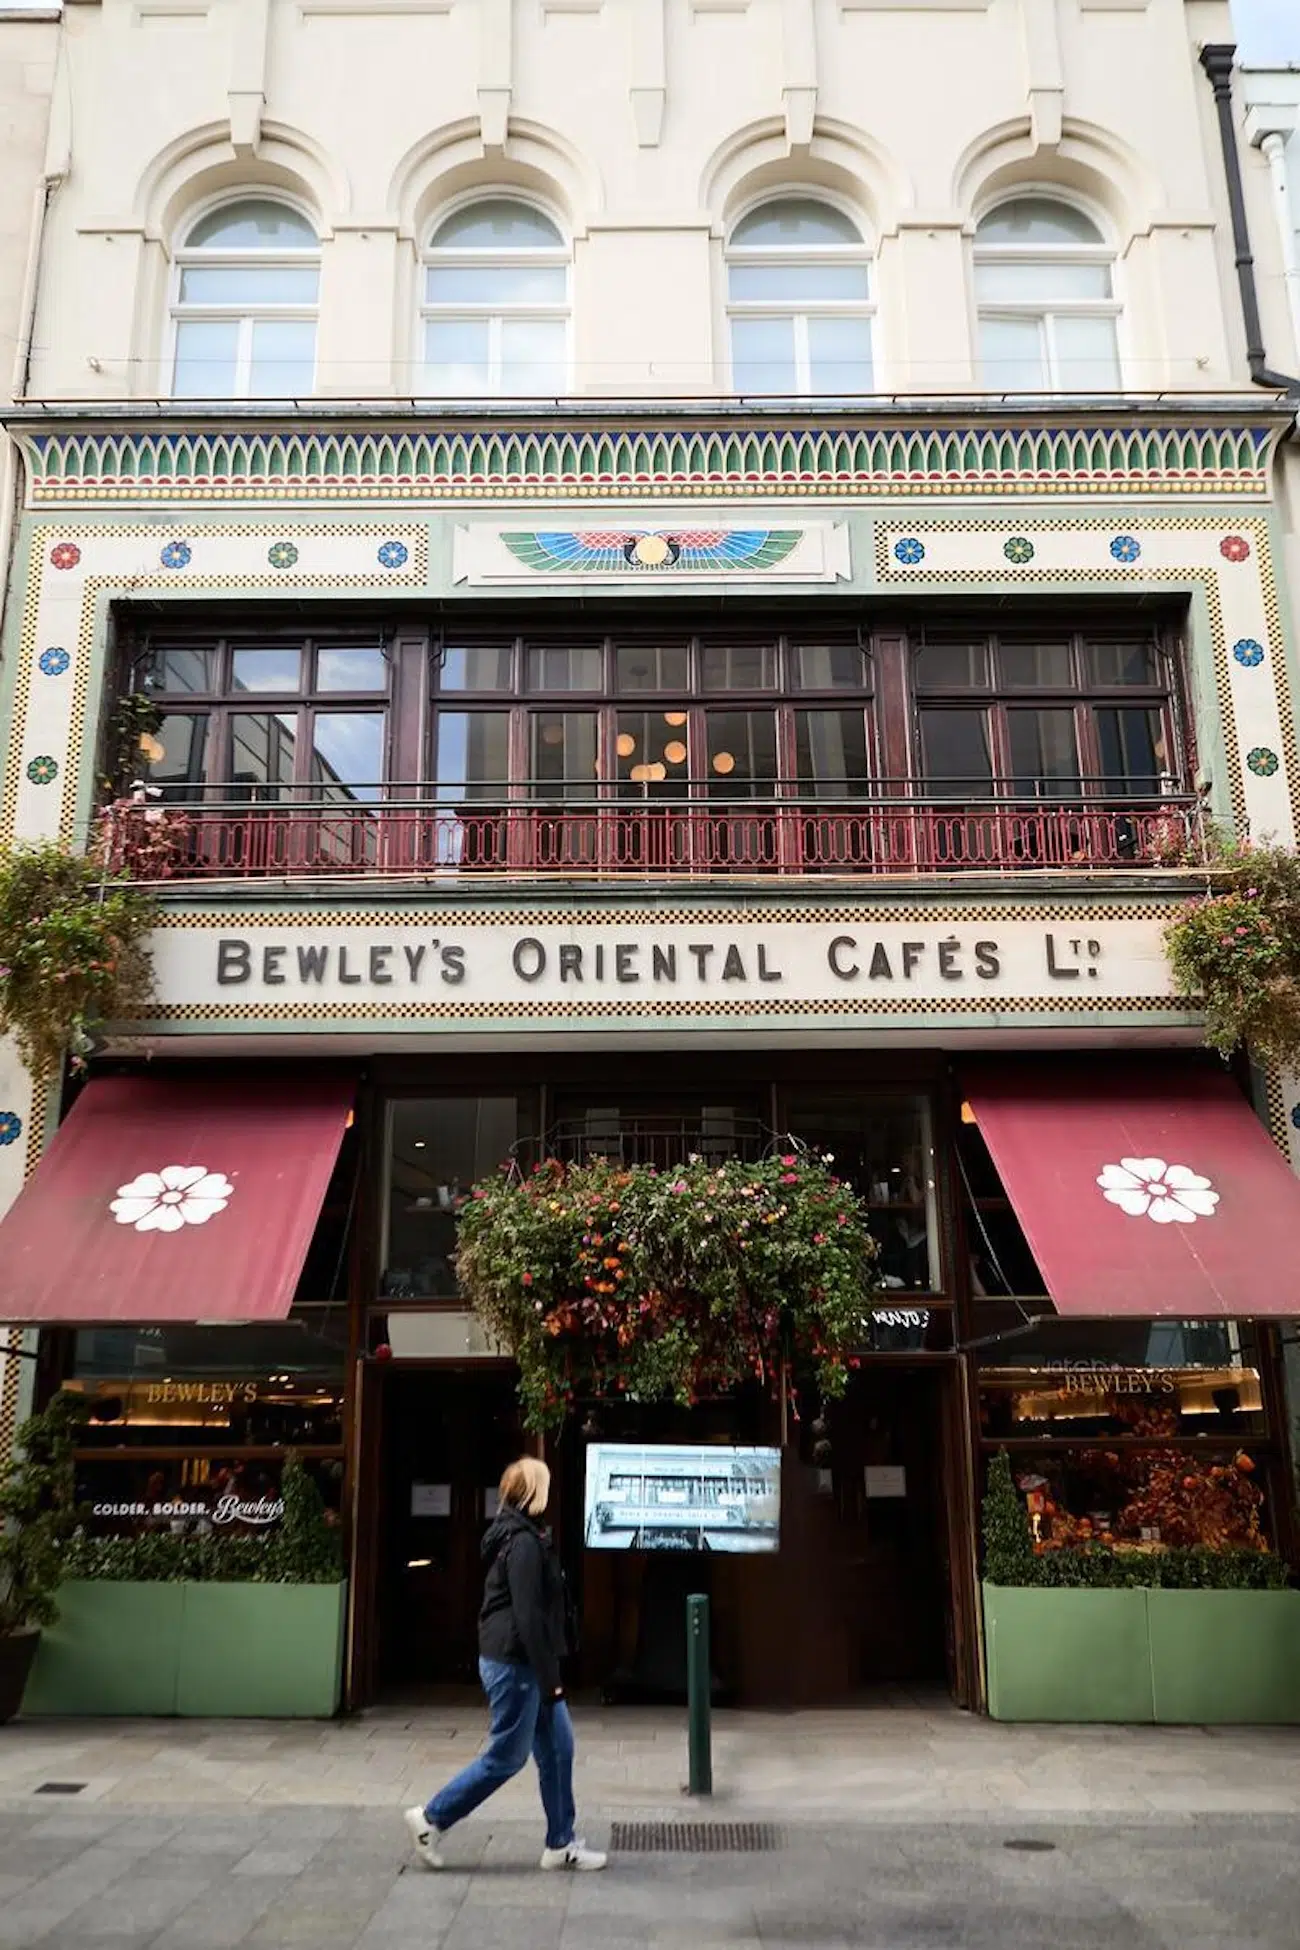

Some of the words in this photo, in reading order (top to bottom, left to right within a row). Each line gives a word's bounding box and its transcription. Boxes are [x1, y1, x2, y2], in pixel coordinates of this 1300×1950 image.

[217, 938, 466, 985] BEWLEY'S
[512, 936, 783, 983] ORIENTAL
[827, 934, 1001, 980] CAFÉS
[147, 1382, 257, 1403] BEWLEY'S
[1064, 1373, 1176, 1394] BEWLEY'S
[212, 1494, 285, 1524] Bewley's
